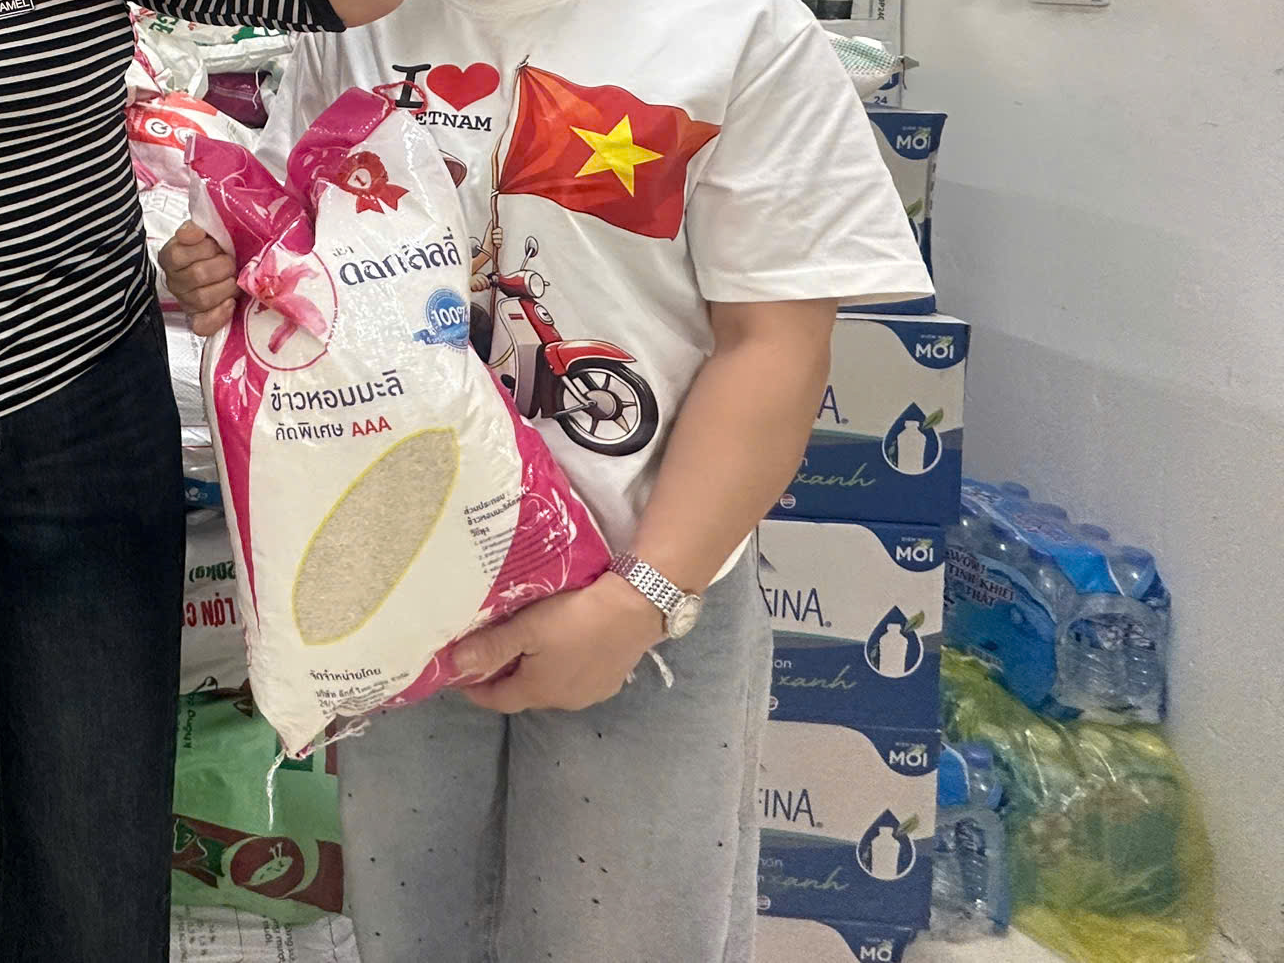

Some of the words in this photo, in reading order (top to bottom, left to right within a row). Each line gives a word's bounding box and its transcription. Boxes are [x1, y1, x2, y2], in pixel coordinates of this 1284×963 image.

[874, 96, 887, 104] 24
[416, 111, 492, 132] ETNAM
[271, 369, 404, 412] ข้าวหอมมะลิ
[352, 415, 393, 438] AAA
[794, 462, 876, 487] xanh
[777, 665, 858, 689] xanh
